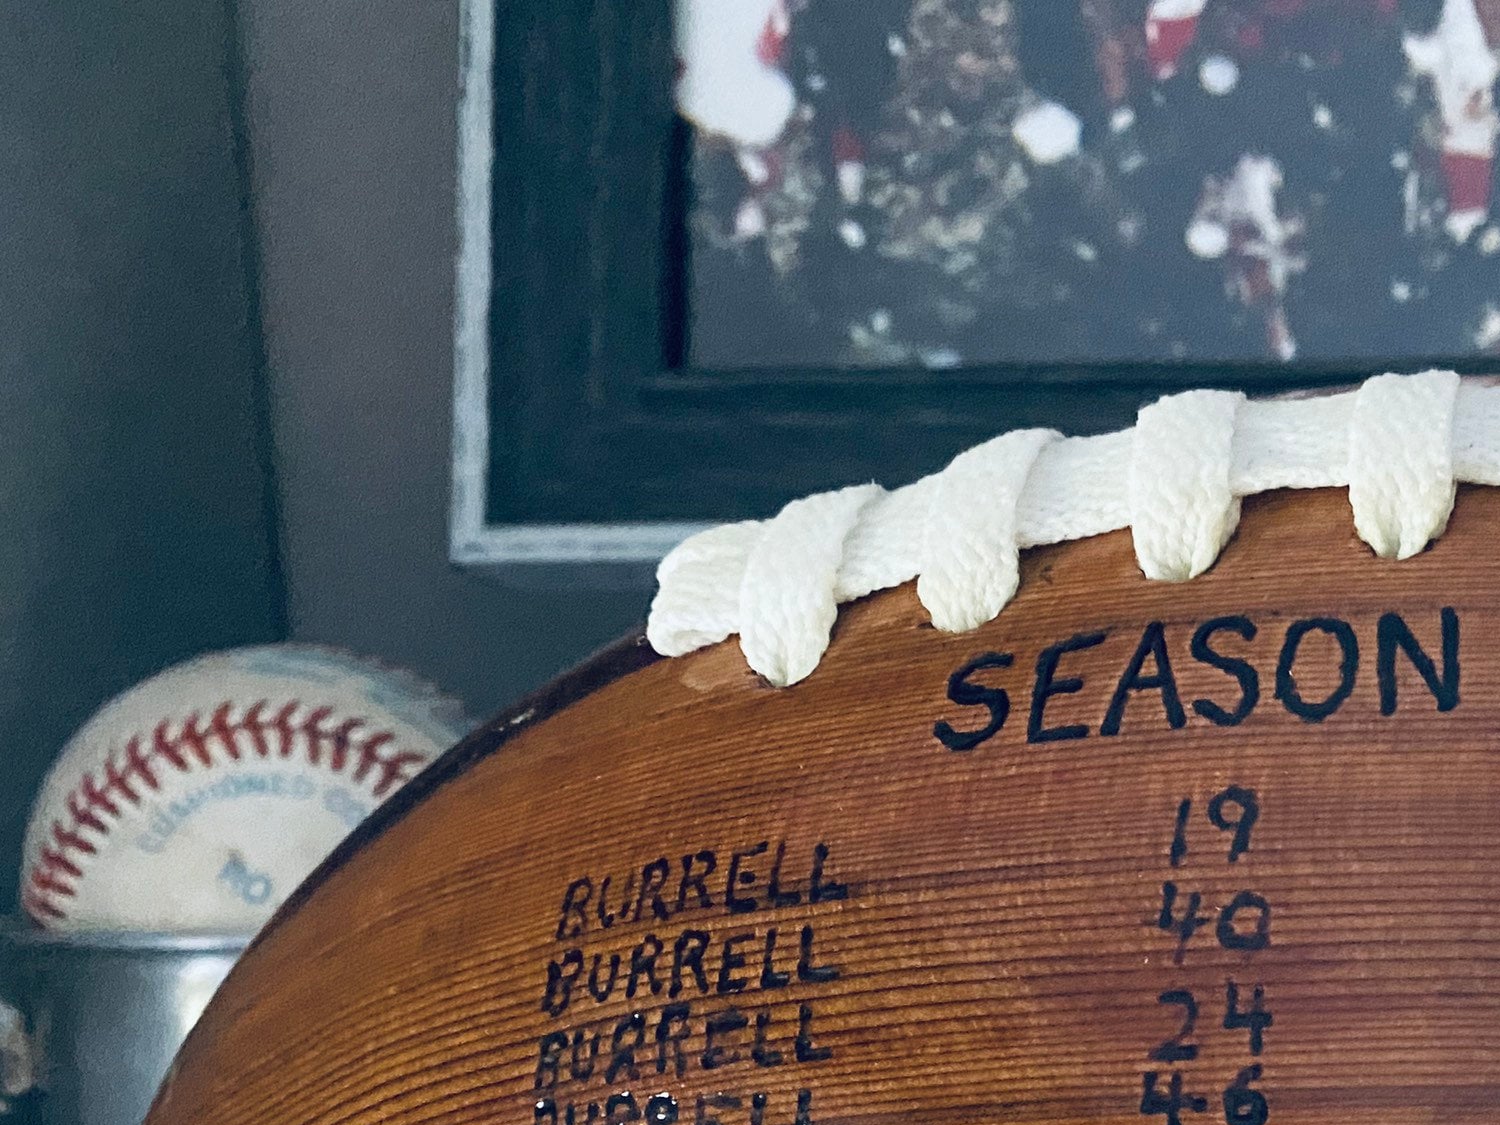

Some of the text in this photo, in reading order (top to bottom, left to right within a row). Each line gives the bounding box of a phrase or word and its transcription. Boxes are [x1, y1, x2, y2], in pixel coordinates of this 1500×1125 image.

[933, 605, 1462, 752] SEASON
[555, 841, 849, 942] BURRELL
[1167, 786, 1262, 866] 19
[543, 926, 841, 1014] BURRELL
[1157, 881, 1273, 963] 40
[534, 1003, 833, 1092] BURRELL
[1147, 977, 1275, 1062] 24
